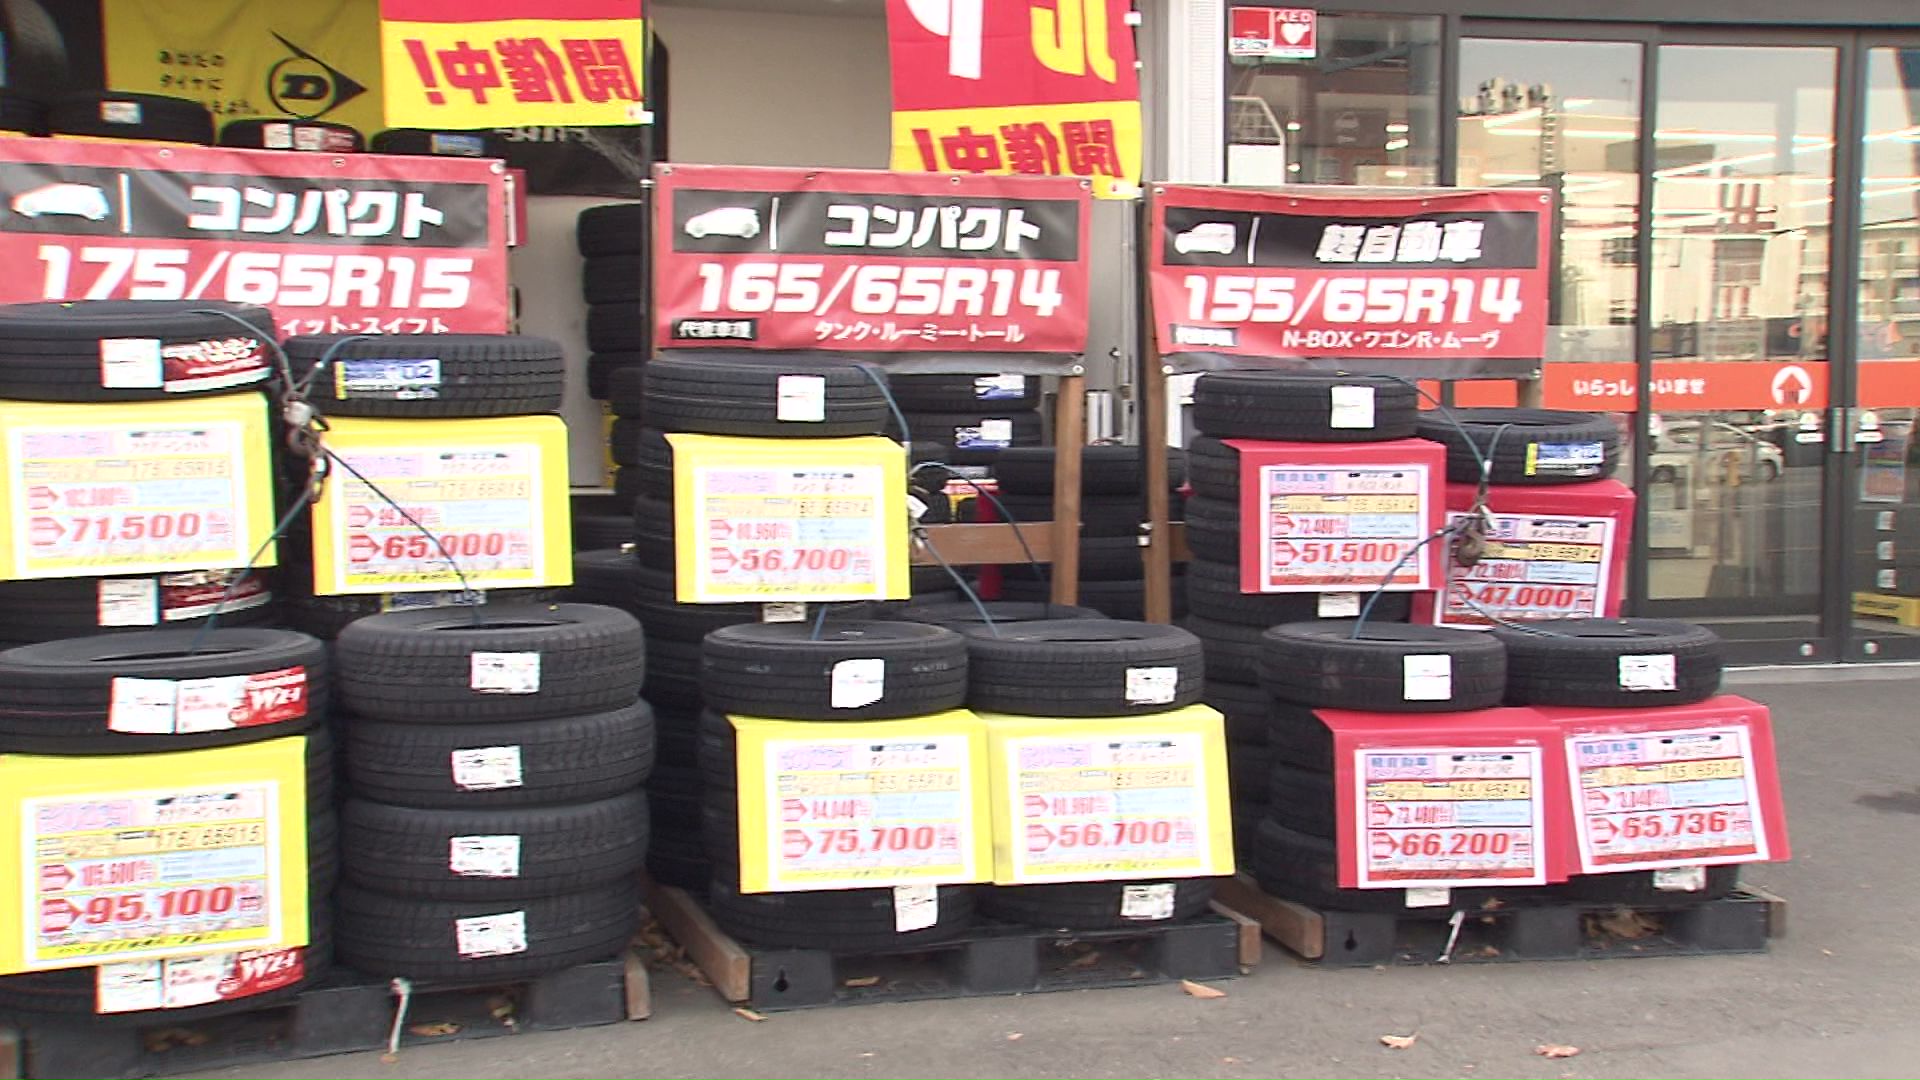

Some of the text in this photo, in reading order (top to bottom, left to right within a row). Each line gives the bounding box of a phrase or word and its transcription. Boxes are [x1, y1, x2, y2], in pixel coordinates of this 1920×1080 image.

[188, 184, 445, 240] コンパクト
[823, 204, 1041, 253] コンパクト
[1315, 219, 1485, 263] 軽自動車
[38, 244, 474, 309] 175/65R15
[698, 263, 1063, 317] 165/65R14
[1184, 275, 1523, 324] 155/65R14
[281, 315, 449, 336] ィット・スイフト
[814, 321, 1025, 344] タンク・ルーミー・トール
[71, 512, 201, 543] 71,500
[383, 532, 504, 560] 65,000
[740, 548, 848, 572] 56,700
[1301, 543, 1397, 564] 51,500
[1478, 585, 1575, 607] 47,000
[1058, 821, 1171, 848] 56,700
[1623, 811, 1727, 839] 65,736
[819, 826, 935, 855] 75,700
[1401, 832, 1510, 857] 66,200
[85, 886, 235, 926] 95,100
